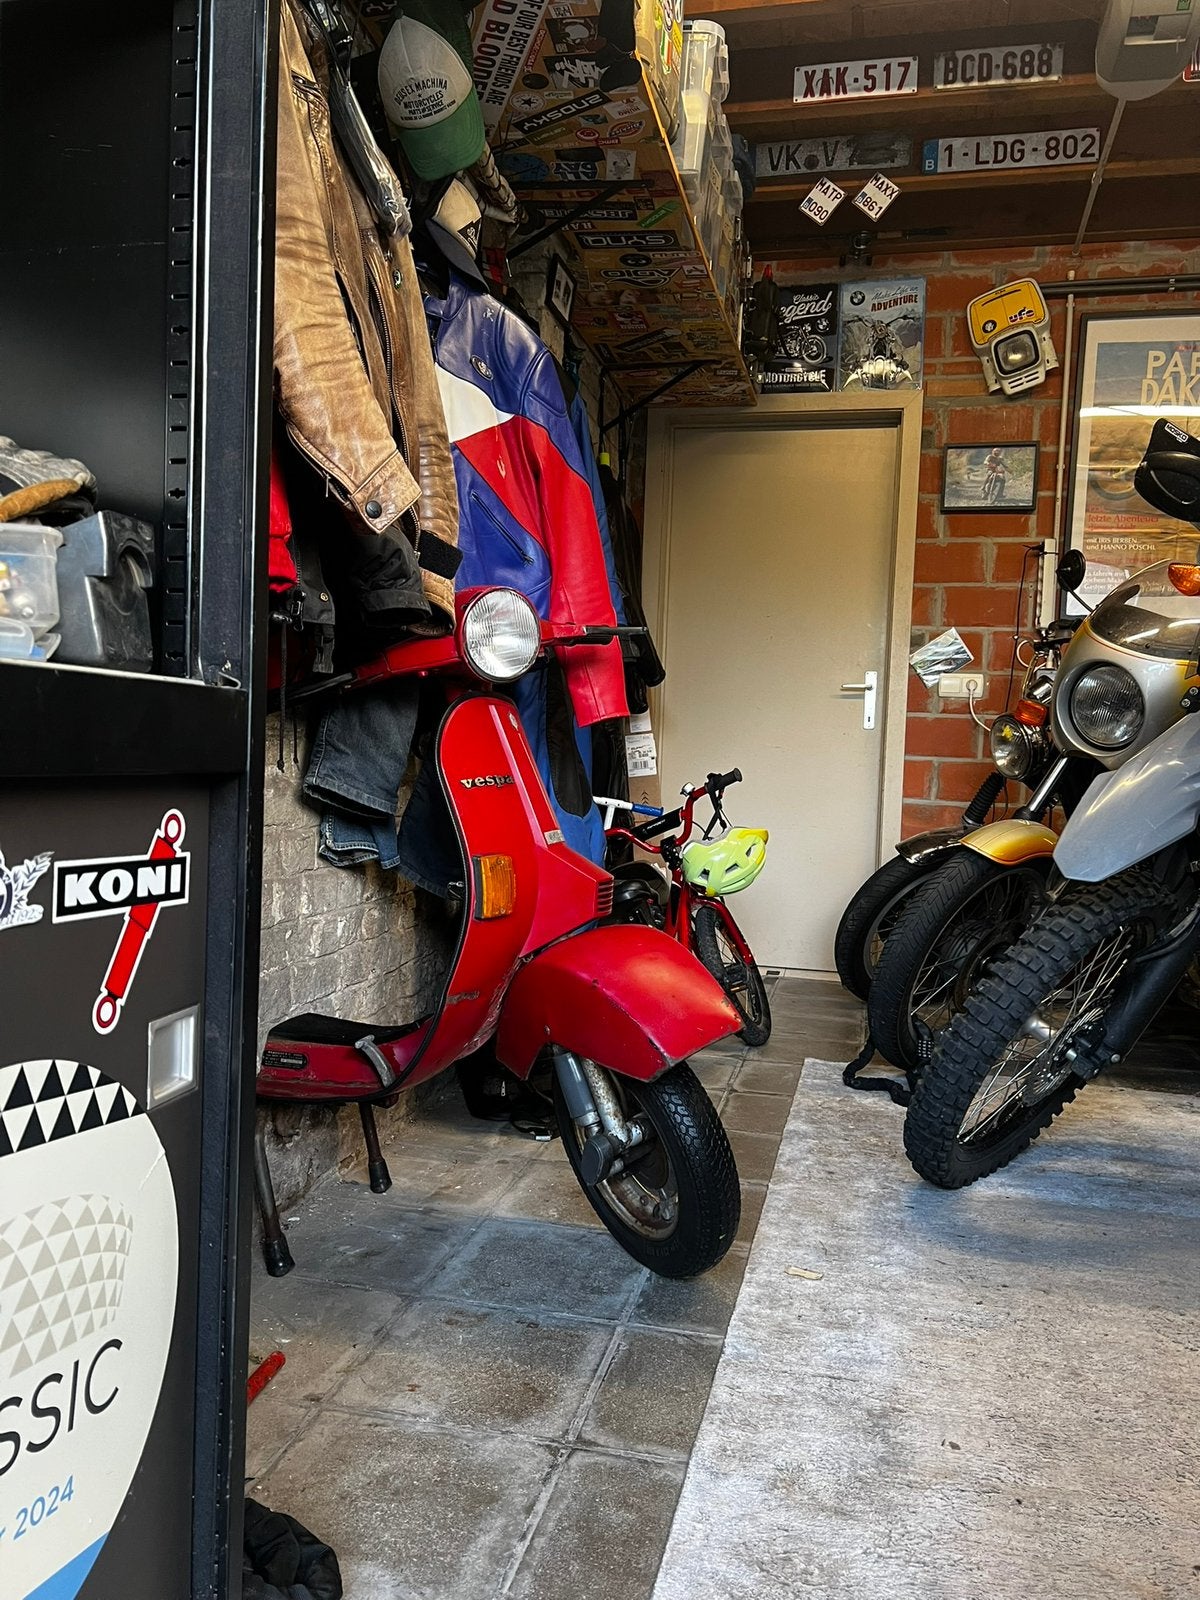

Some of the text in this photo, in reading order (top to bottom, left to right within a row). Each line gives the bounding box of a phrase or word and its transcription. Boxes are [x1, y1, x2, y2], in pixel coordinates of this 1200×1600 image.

[514, 9, 539, 30] OUR
[506, 30, 531, 54] BEST
[492, 54, 521, 89] FRIENDS
[415, 78, 448, 91] MACHINA
[403, 90, 444, 109] MOTORCYCLES
[485, 88, 507, 106] ARE
[943, 133, 1097, 168] 1-LDG-802
[925, 159, 936, 171] B
[815, 179, 842, 202] MATP
[870, 175, 899, 200] MAXX
[808, 201, 829, 221] 090
[862, 196, 883, 217] 861
[870, 294, 919, 312] ADVENTURE
[1165, 423, 1188, 442] MOSKO
[460, 775, 516, 789] vespa
[64, 864, 182, 907] KONI
[13, 1474, 74, 1540] 2024
